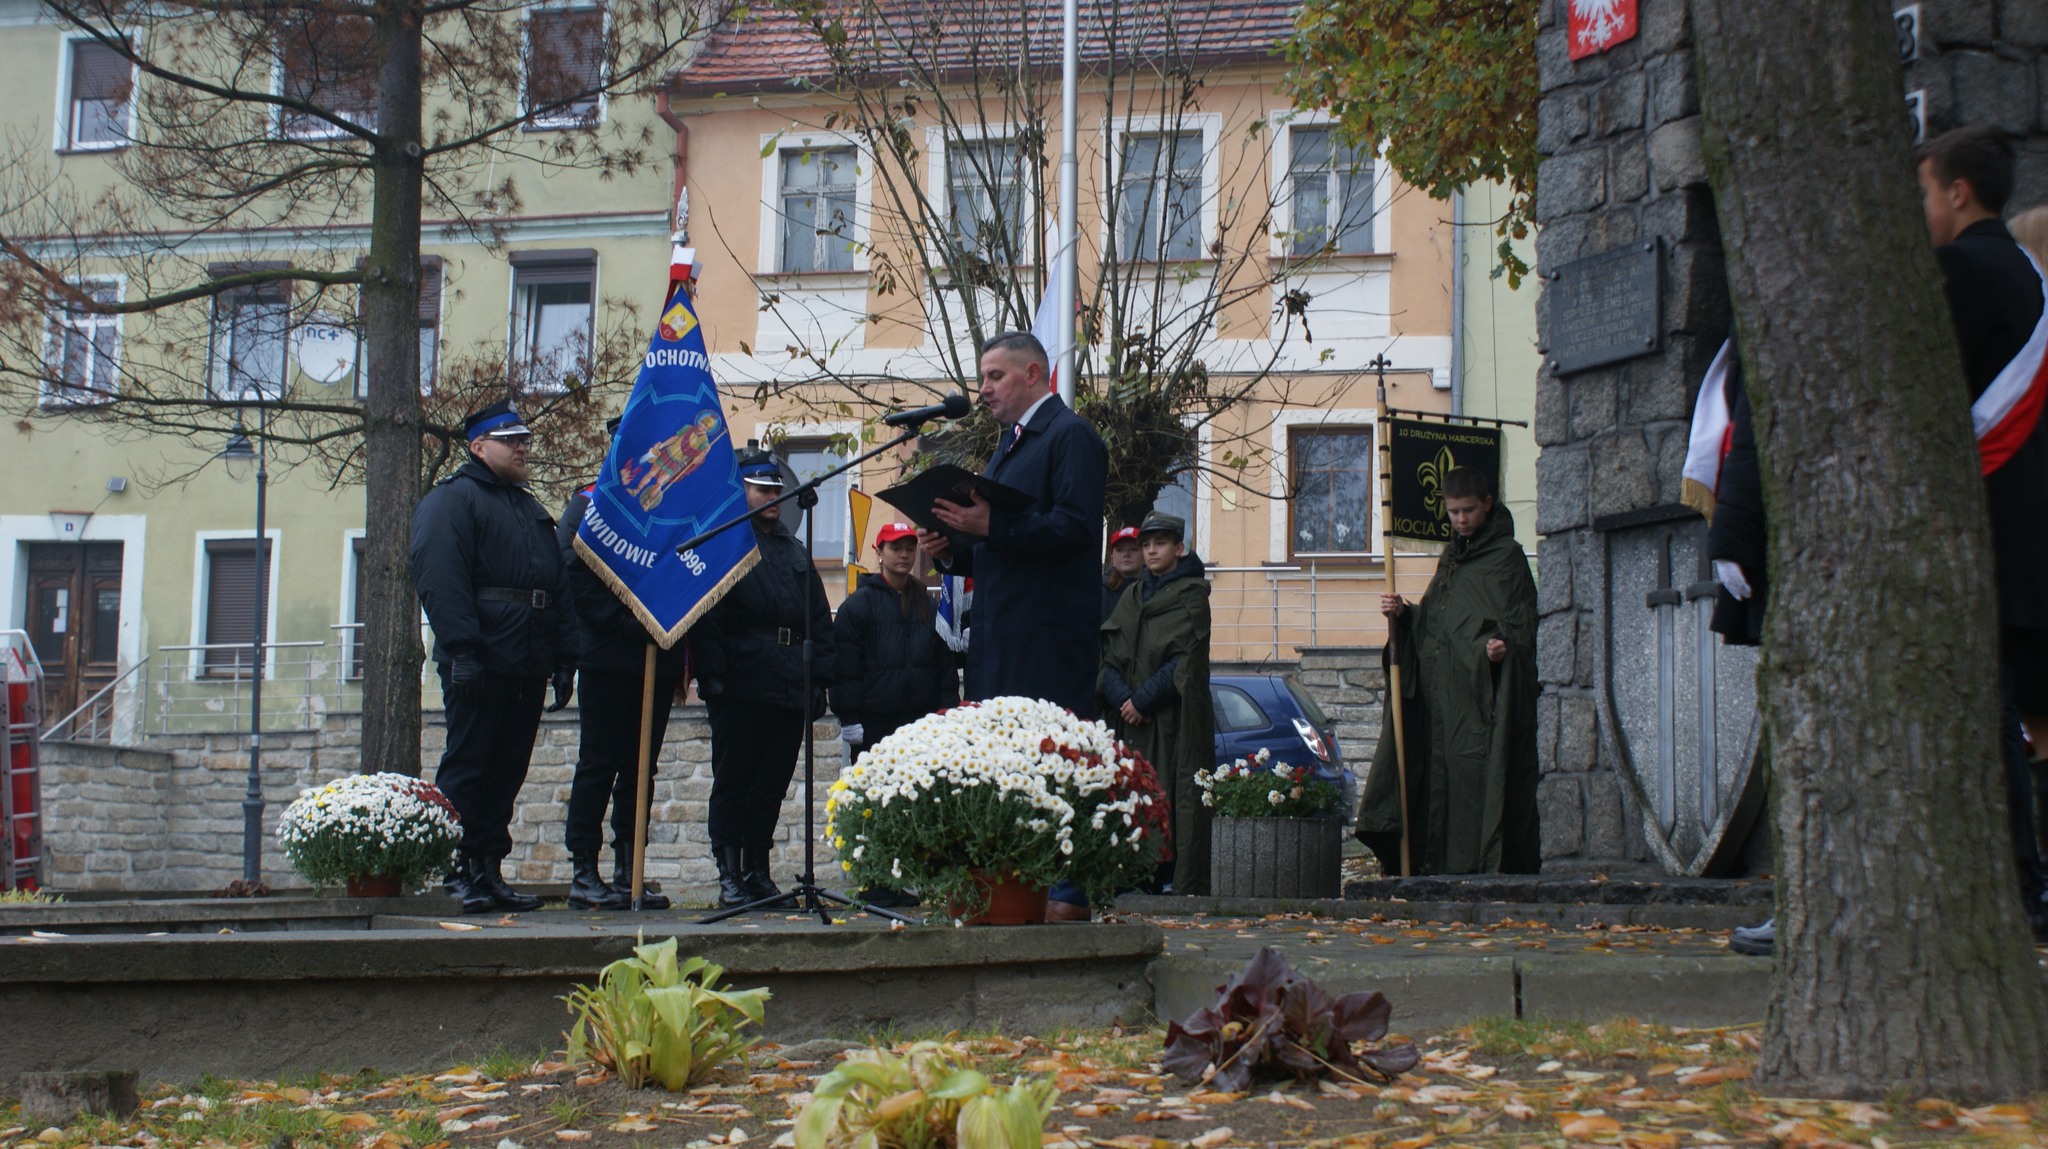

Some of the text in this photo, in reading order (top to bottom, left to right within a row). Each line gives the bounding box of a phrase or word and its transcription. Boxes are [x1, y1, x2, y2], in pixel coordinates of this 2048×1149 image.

[1399, 428, 1409, 436] 10
[1449, 434, 1495, 446] HARCERSKA
[1394, 516, 1436, 536] KOCIA
[676, 549, 706, 576] 996
